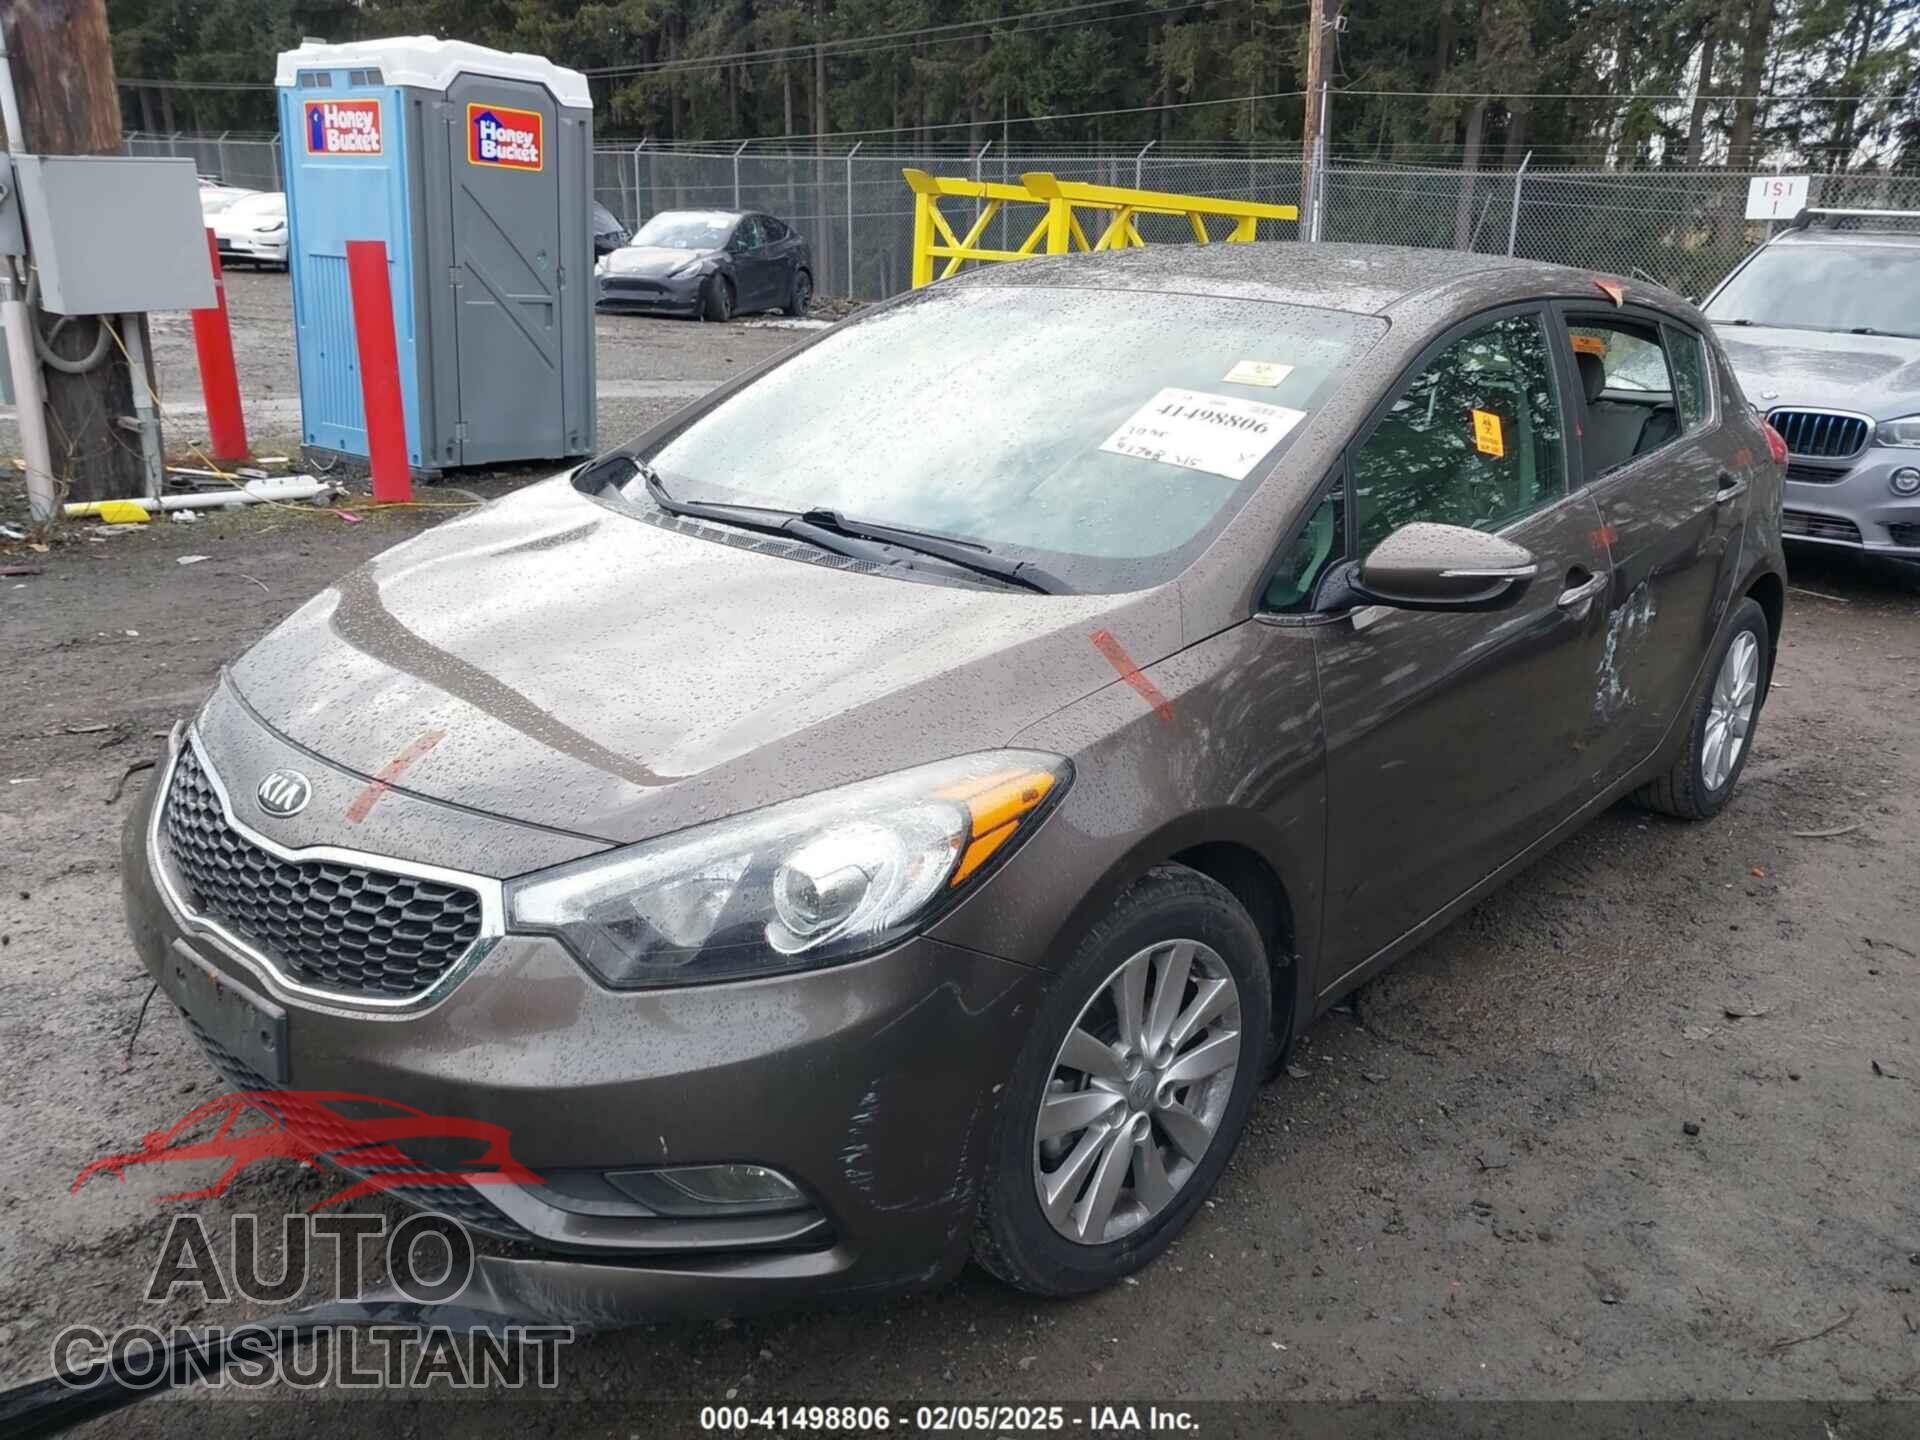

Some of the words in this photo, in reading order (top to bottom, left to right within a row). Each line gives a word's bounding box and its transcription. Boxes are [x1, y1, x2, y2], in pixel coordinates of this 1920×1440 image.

[323, 103, 374, 130] Honey
[326, 127, 381, 152] Bucket
[479, 119, 535, 147] Honey
[480, 139, 539, 162] Bucket
[1154, 402, 1269, 435] 41498806
[259, 773, 301, 811] KIA
